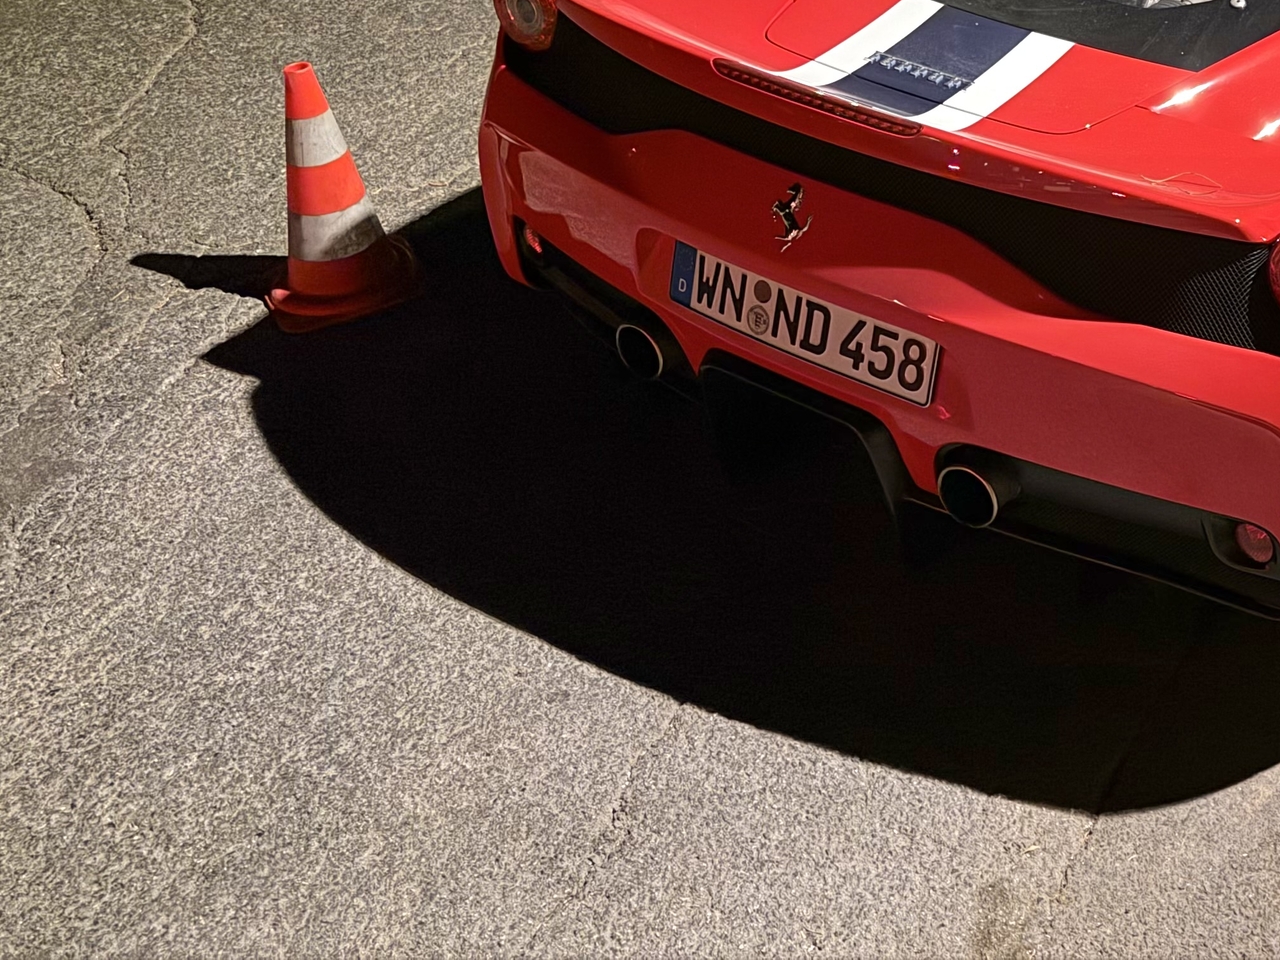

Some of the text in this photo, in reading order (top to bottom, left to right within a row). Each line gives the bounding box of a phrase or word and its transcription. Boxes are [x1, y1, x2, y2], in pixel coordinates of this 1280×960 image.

[678, 254, 927, 392] D WN ND 458
